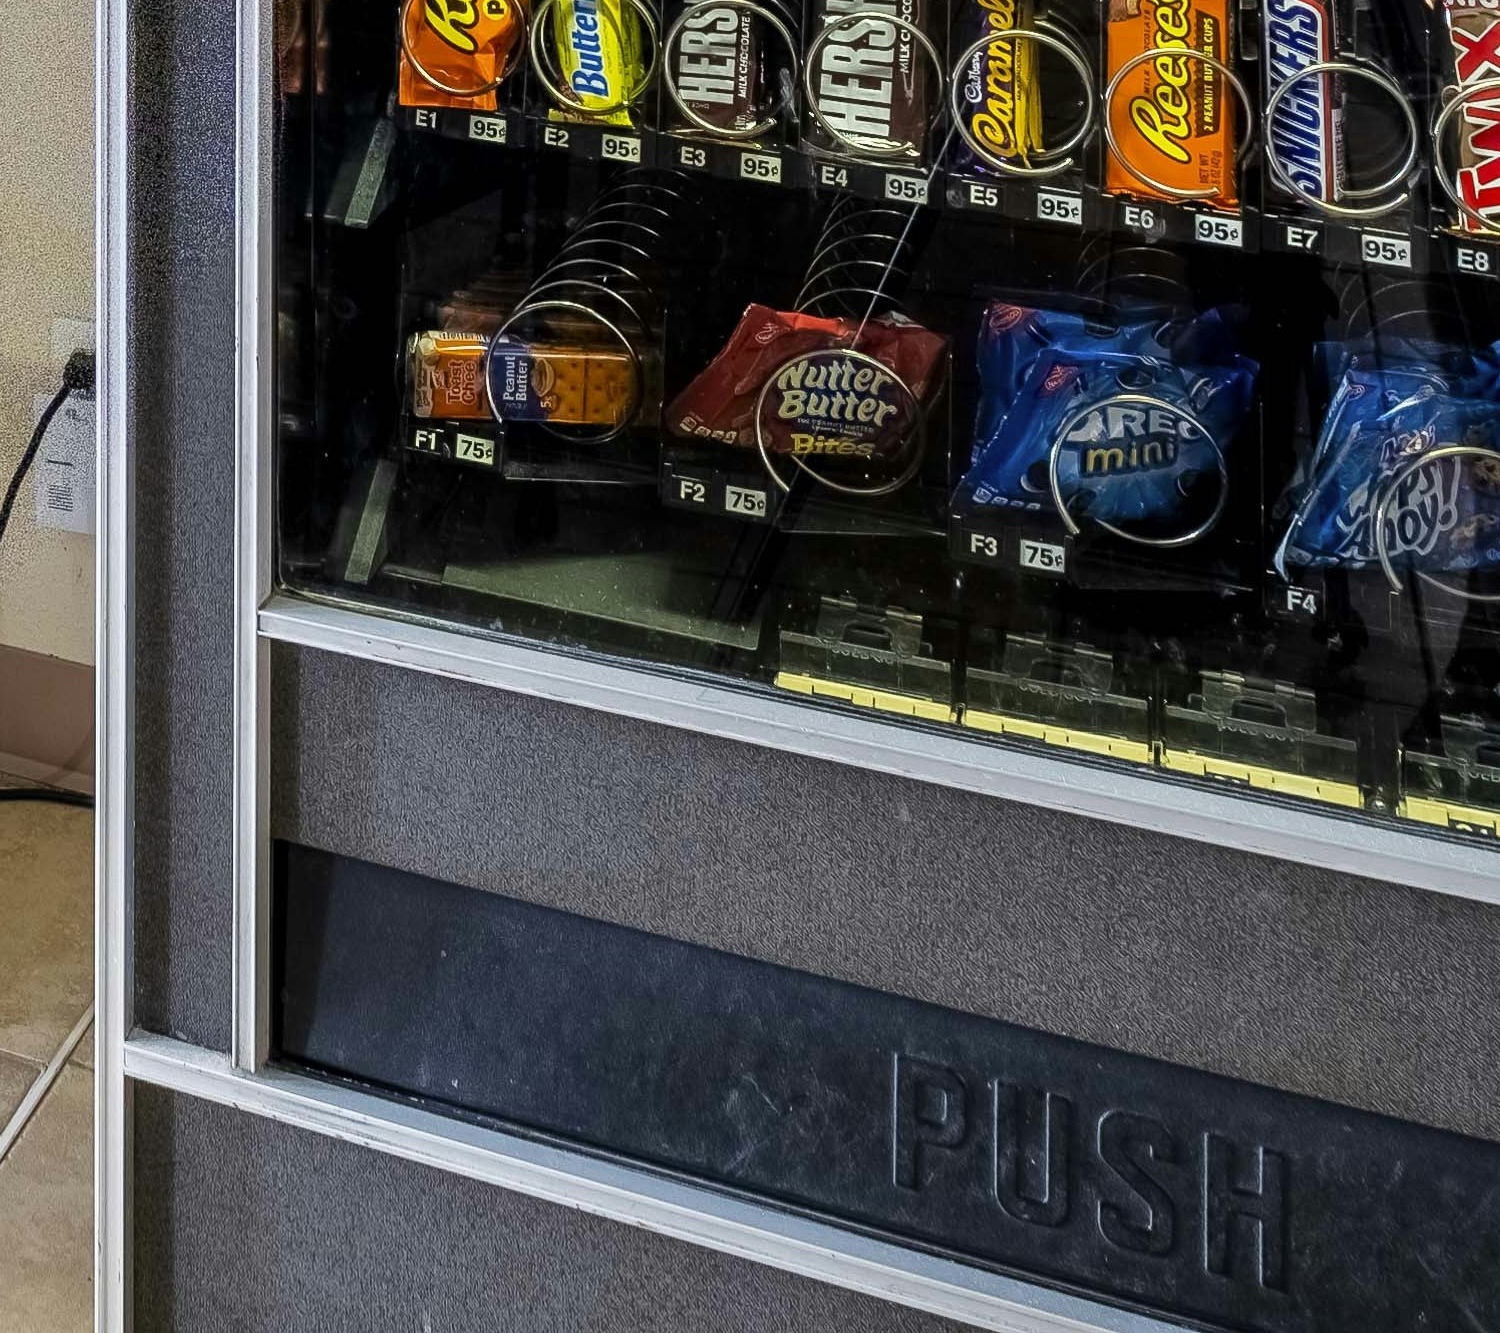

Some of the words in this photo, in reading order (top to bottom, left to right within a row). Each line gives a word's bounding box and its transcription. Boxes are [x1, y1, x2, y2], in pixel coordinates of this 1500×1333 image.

[1203, 17, 1214, 43] CUPS
[900, 40, 910, 74] MILK
[1203, 84, 1214, 122] PEANUT
[416, 109, 437, 128] E1
[1204, 122, 1214, 131] 2
[545, 128, 569, 147] E2
[681, 147, 706, 167] E3
[822, 165, 848, 187] E4
[970, 185, 998, 205] E5
[1125, 208, 1154, 229] E6
[1287, 226, 1318, 248] E7
[1457, 249, 1489, 271] E8
[502, 356, 515, 401] Peanut
[515, 360, 528, 401] Butter
[777, 360, 894, 396] Nutter
[779, 390, 898, 427] Butter
[415, 431, 436, 450] F1
[790, 433, 875, 456] Bites
[1086, 437, 1176, 473] mini
[680, 480, 705, 502] F2
[970, 533, 998, 557] F3
[1287, 590, 1317, 615] F4
[892, 1051, 1290, 1295] PUSH
